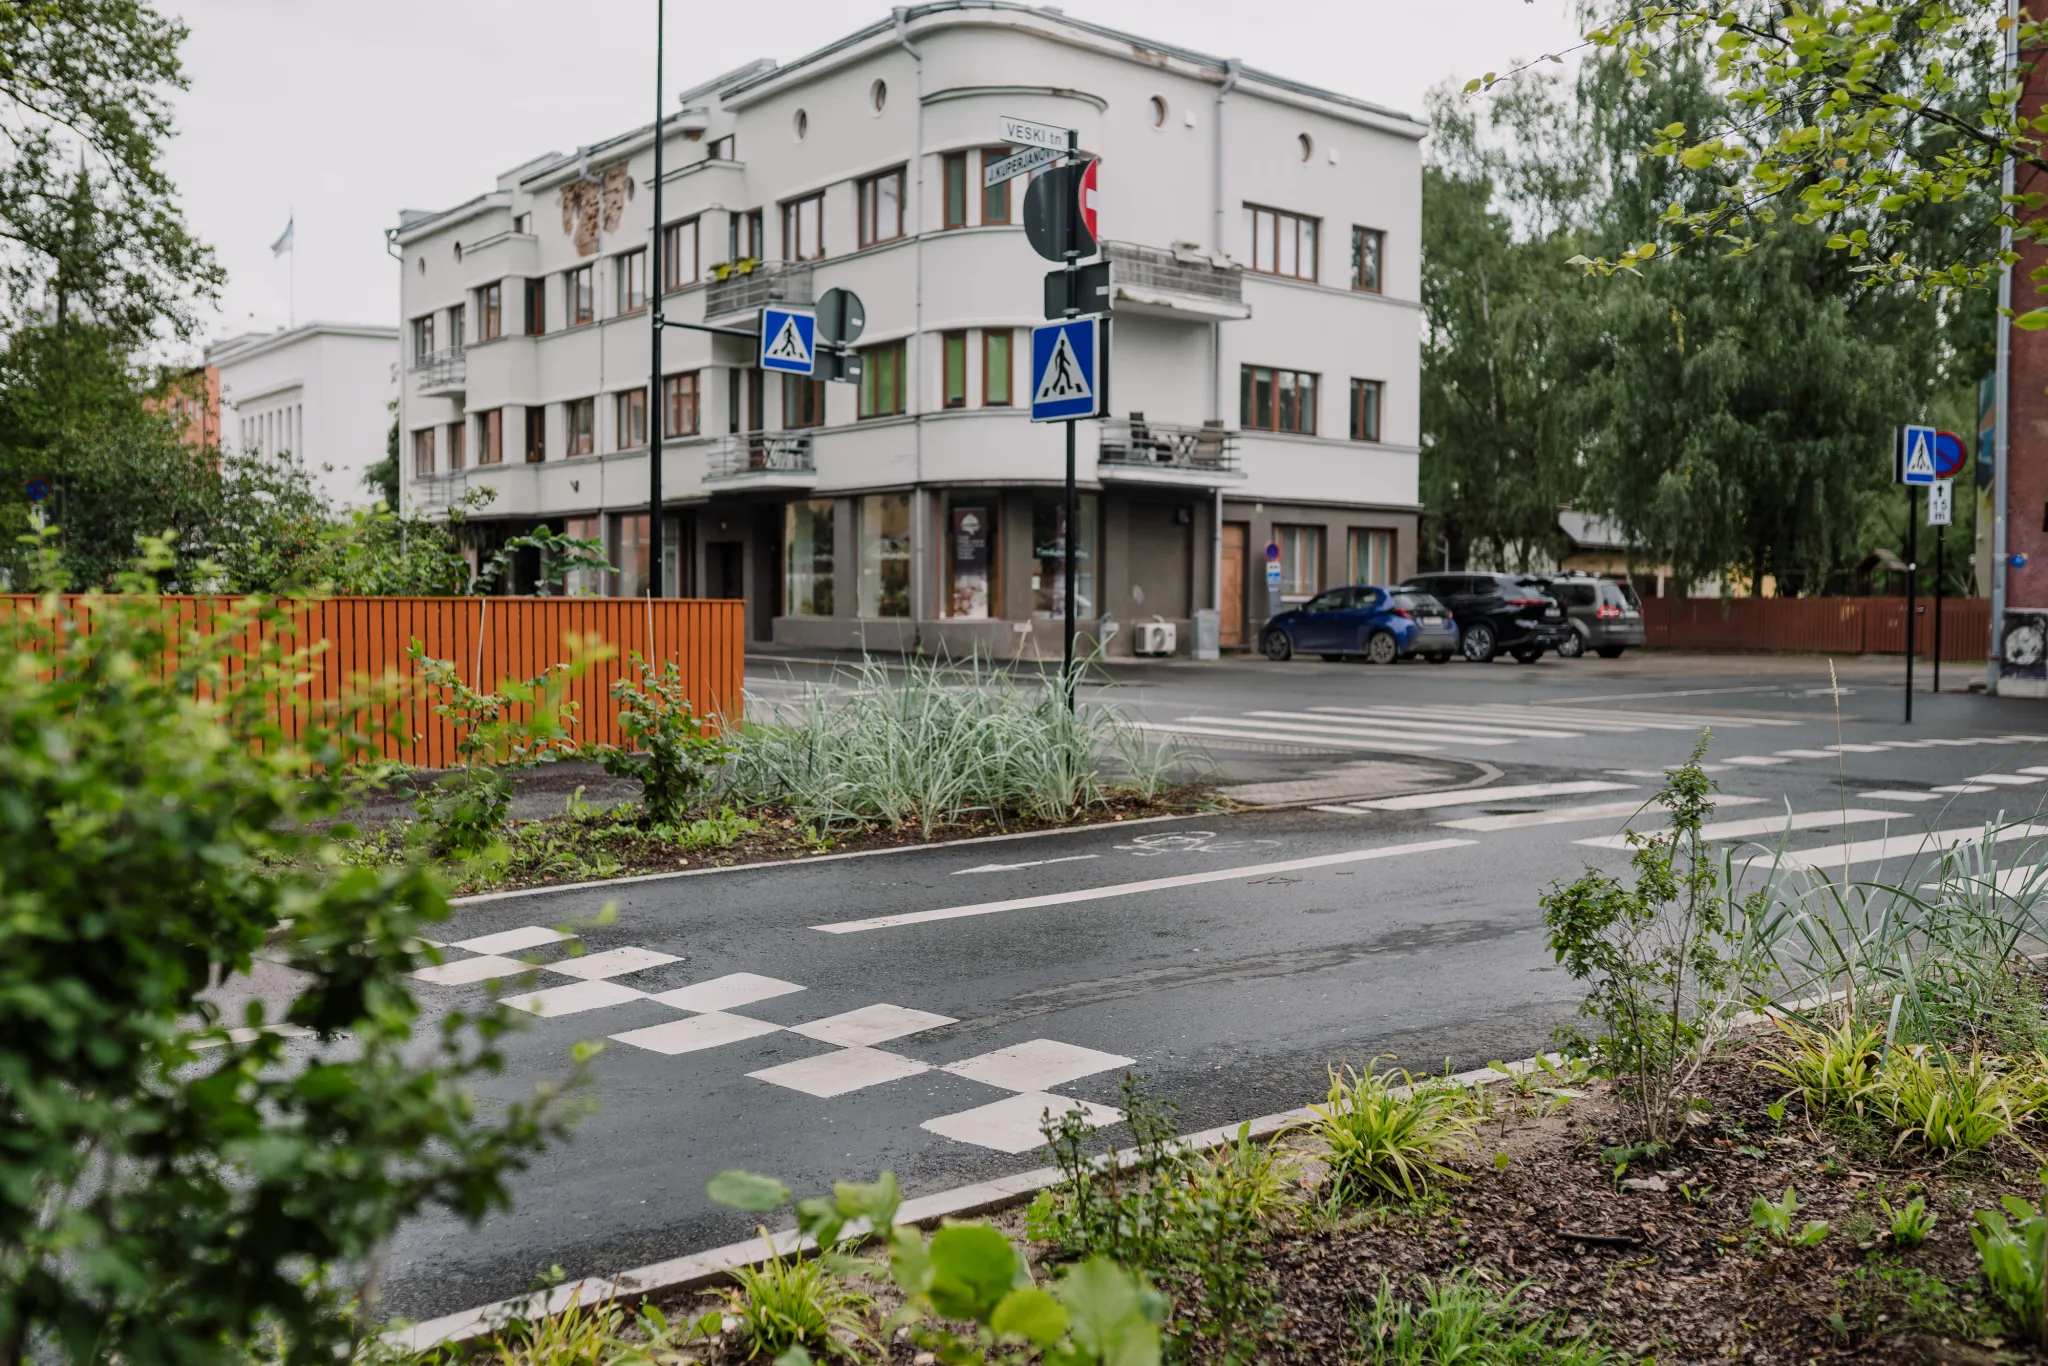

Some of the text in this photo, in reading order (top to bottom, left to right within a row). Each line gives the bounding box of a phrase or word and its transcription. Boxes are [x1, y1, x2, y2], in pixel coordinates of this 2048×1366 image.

[1007, 123, 1062, 145] VESKI tn
[1934, 500, 1948, 510] 15
